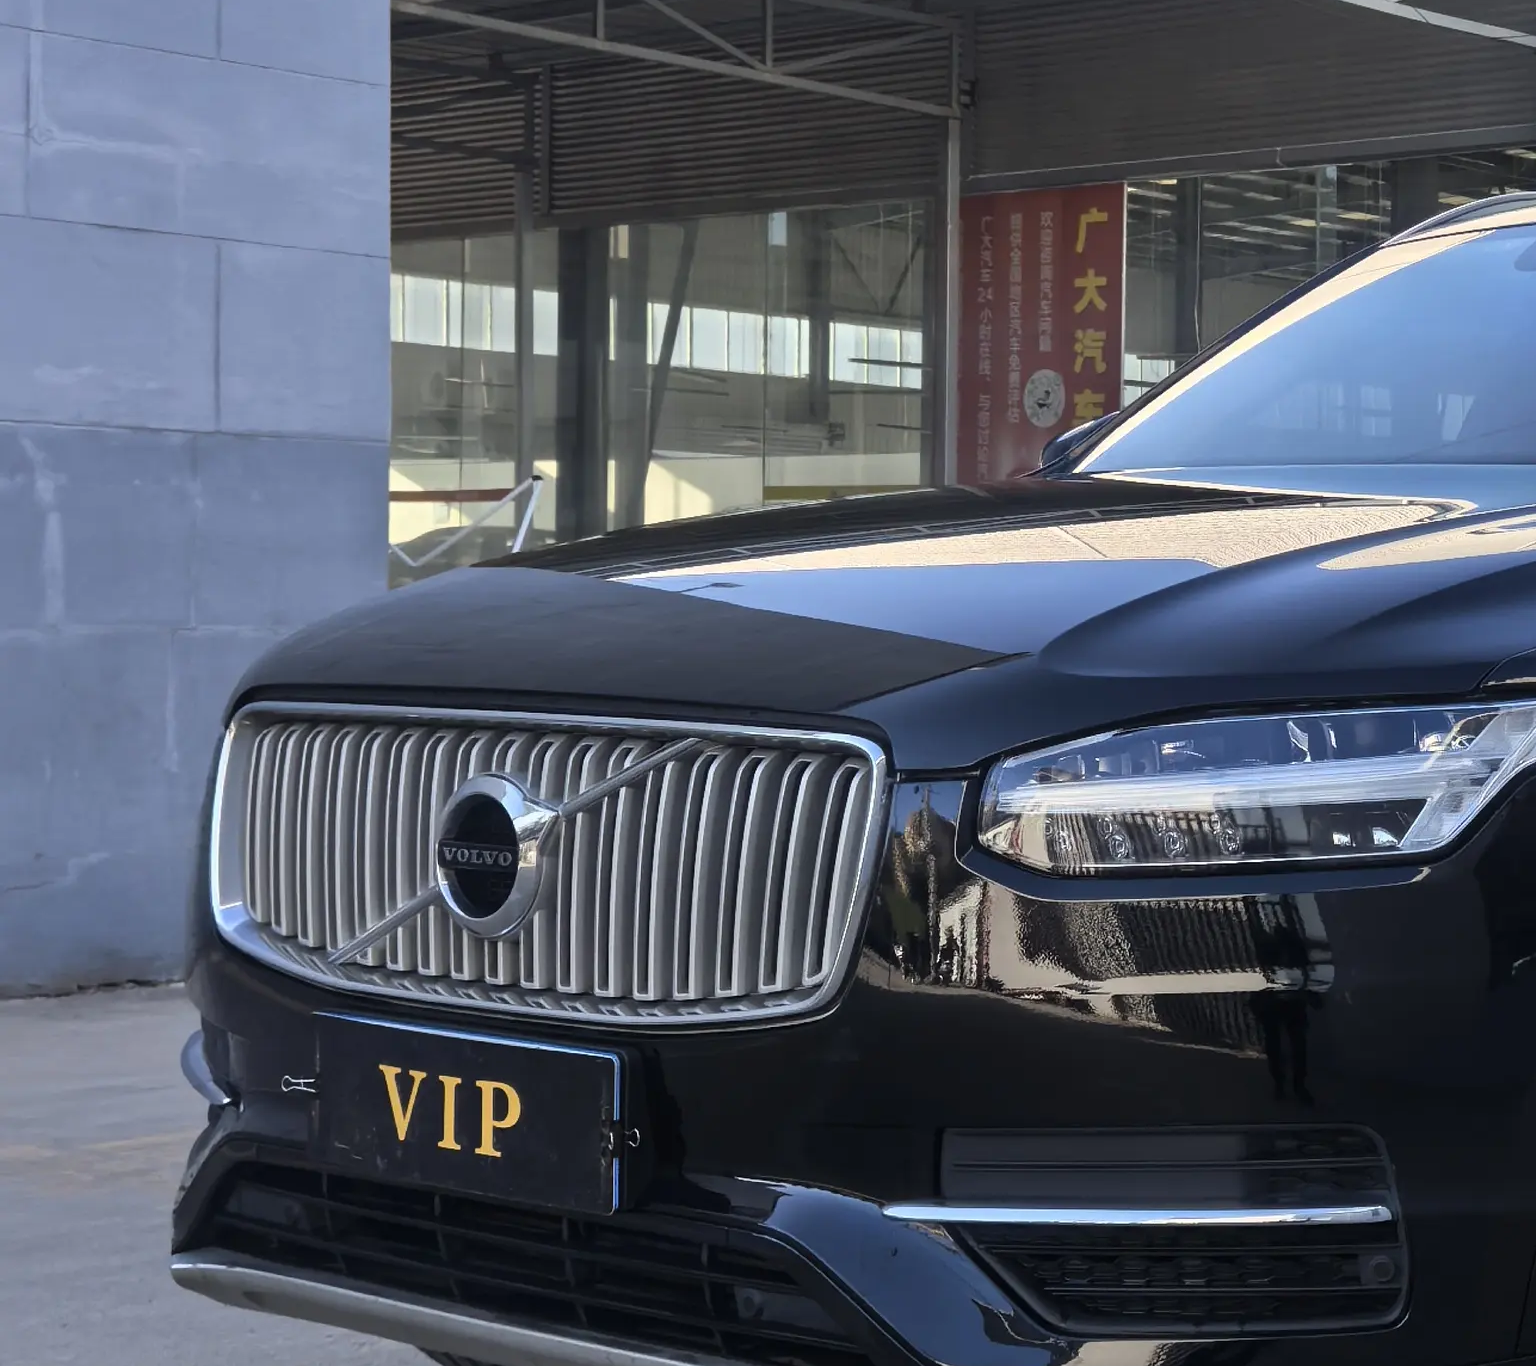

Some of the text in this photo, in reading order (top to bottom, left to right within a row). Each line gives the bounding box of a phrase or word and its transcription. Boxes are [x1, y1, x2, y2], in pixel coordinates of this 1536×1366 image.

[1072, 207, 1109, 428] 广大汽车
[443, 847, 513, 867] VOLVO
[379, 1064, 521, 1157] VIP
